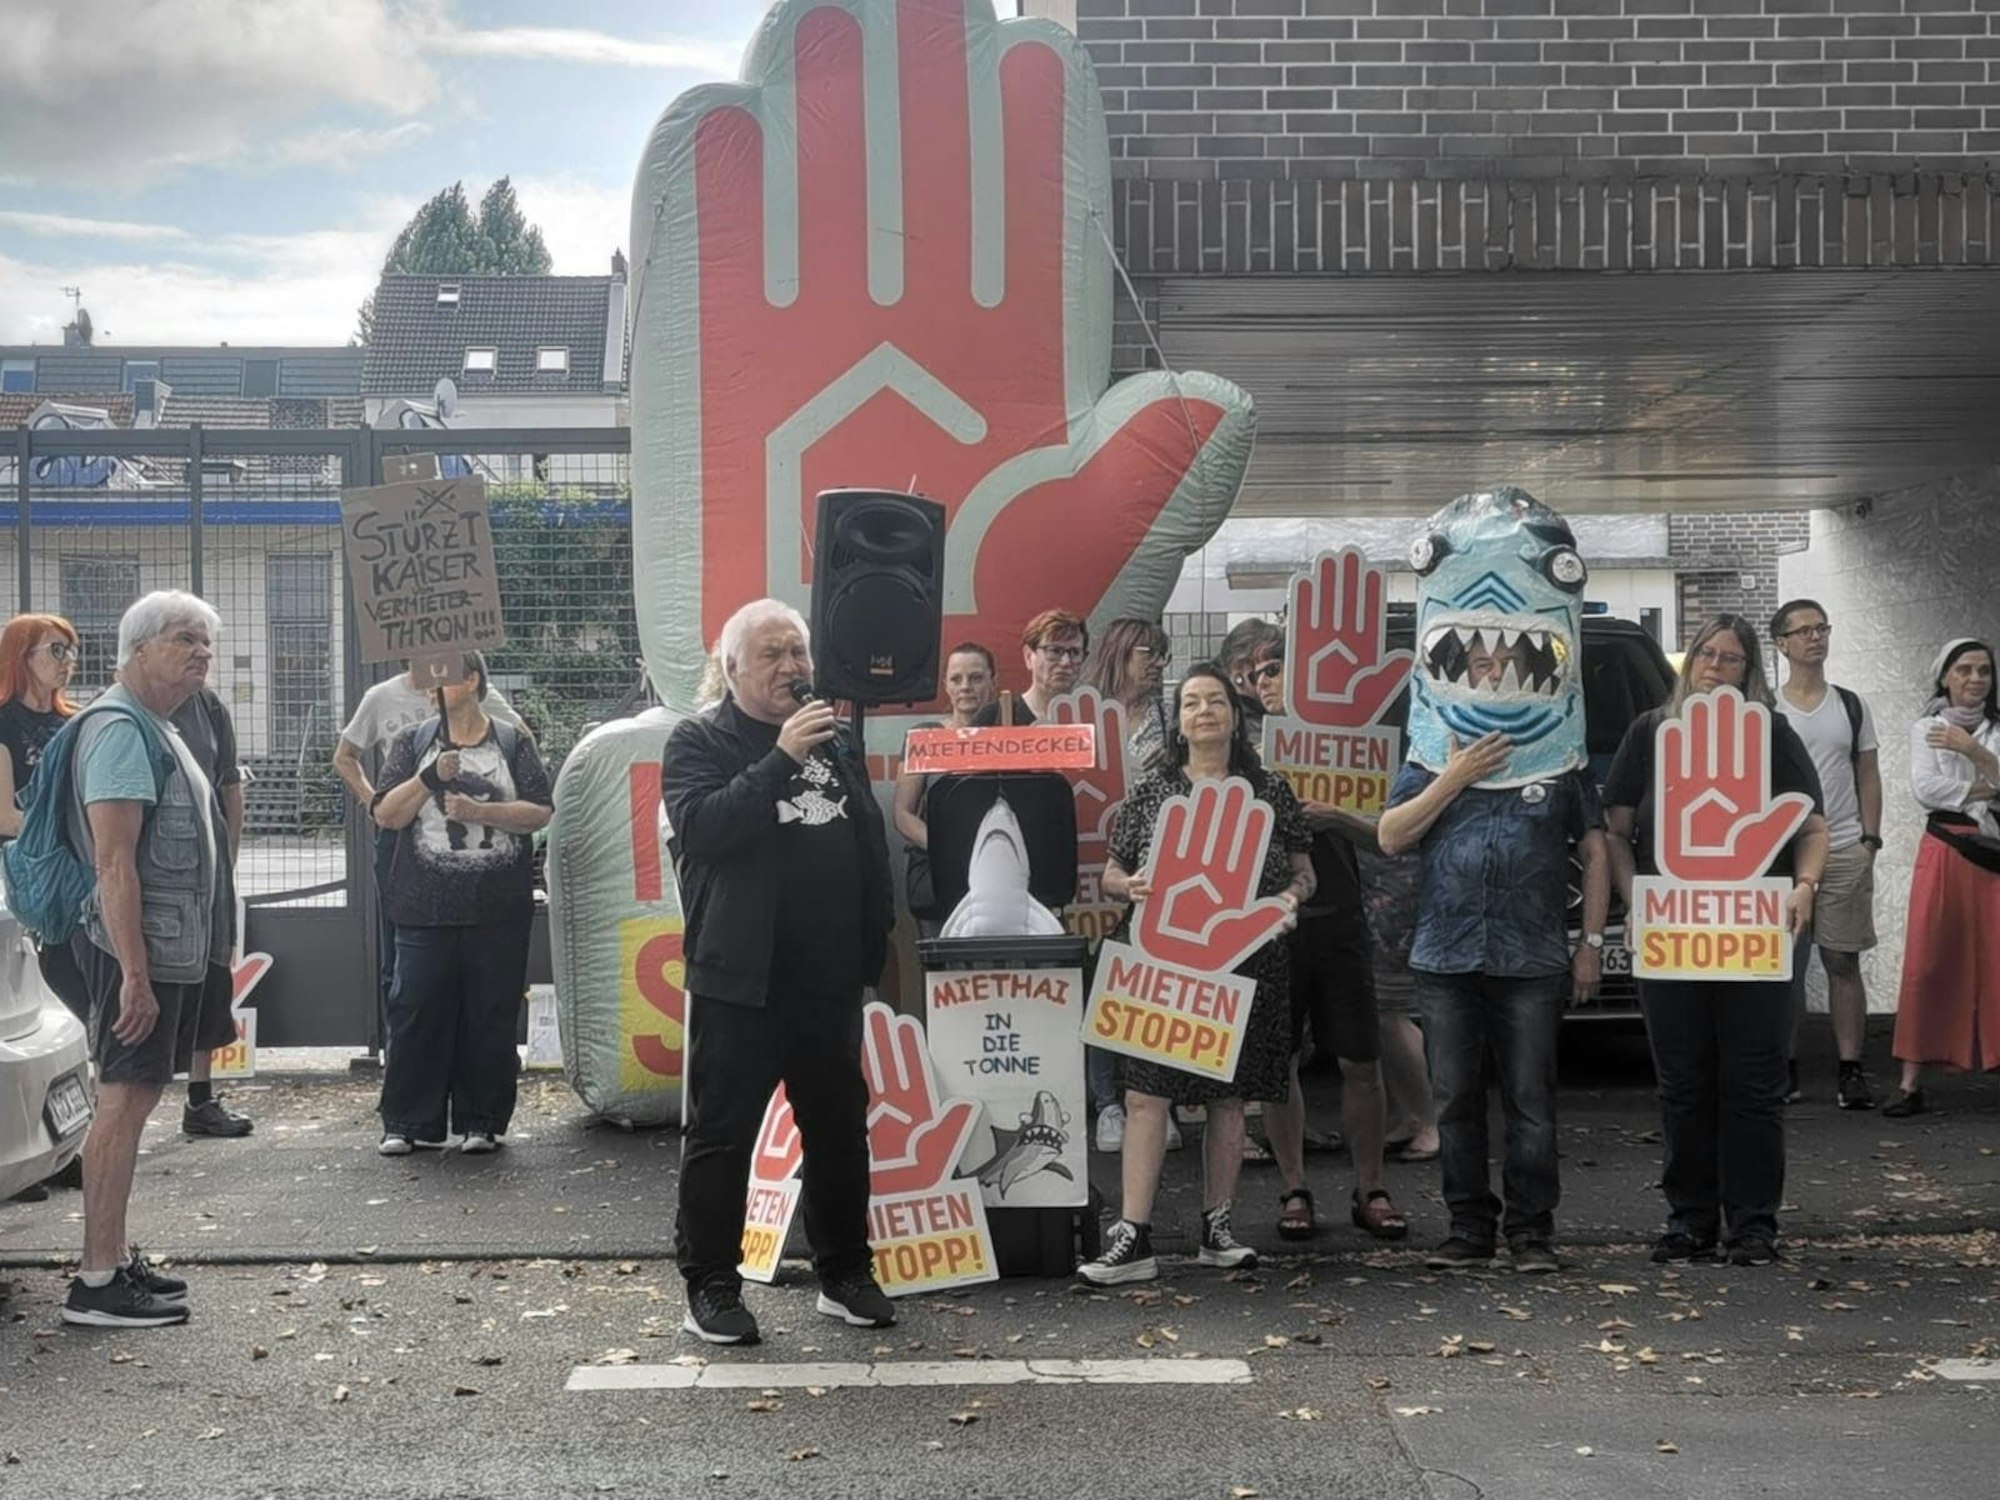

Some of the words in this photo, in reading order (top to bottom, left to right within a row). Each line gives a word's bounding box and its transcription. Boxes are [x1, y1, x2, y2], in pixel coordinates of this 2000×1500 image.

[352, 510, 482, 561] STÜRZT
[908, 736, 1092, 758] MIETENDECKEL
[1274, 728, 1390, 772] MIETEN
[1645, 887, 1779, 926] MIETEN
[1643, 931, 1780, 969] STOPP!
[933, 973, 1070, 1009] MIETHAI
[1106, 955, 1241, 1025] MIETEN
[985, 1013, 1012, 1031] IN
[1095, 1000, 1230, 1067] STOPP!
[982, 1034, 1021, 1053] DIE
[963, 1056, 1041, 1076] TONNE
[866, 1192, 974, 1242] IETEN
[873, 1234, 984, 1284] TOPP!
